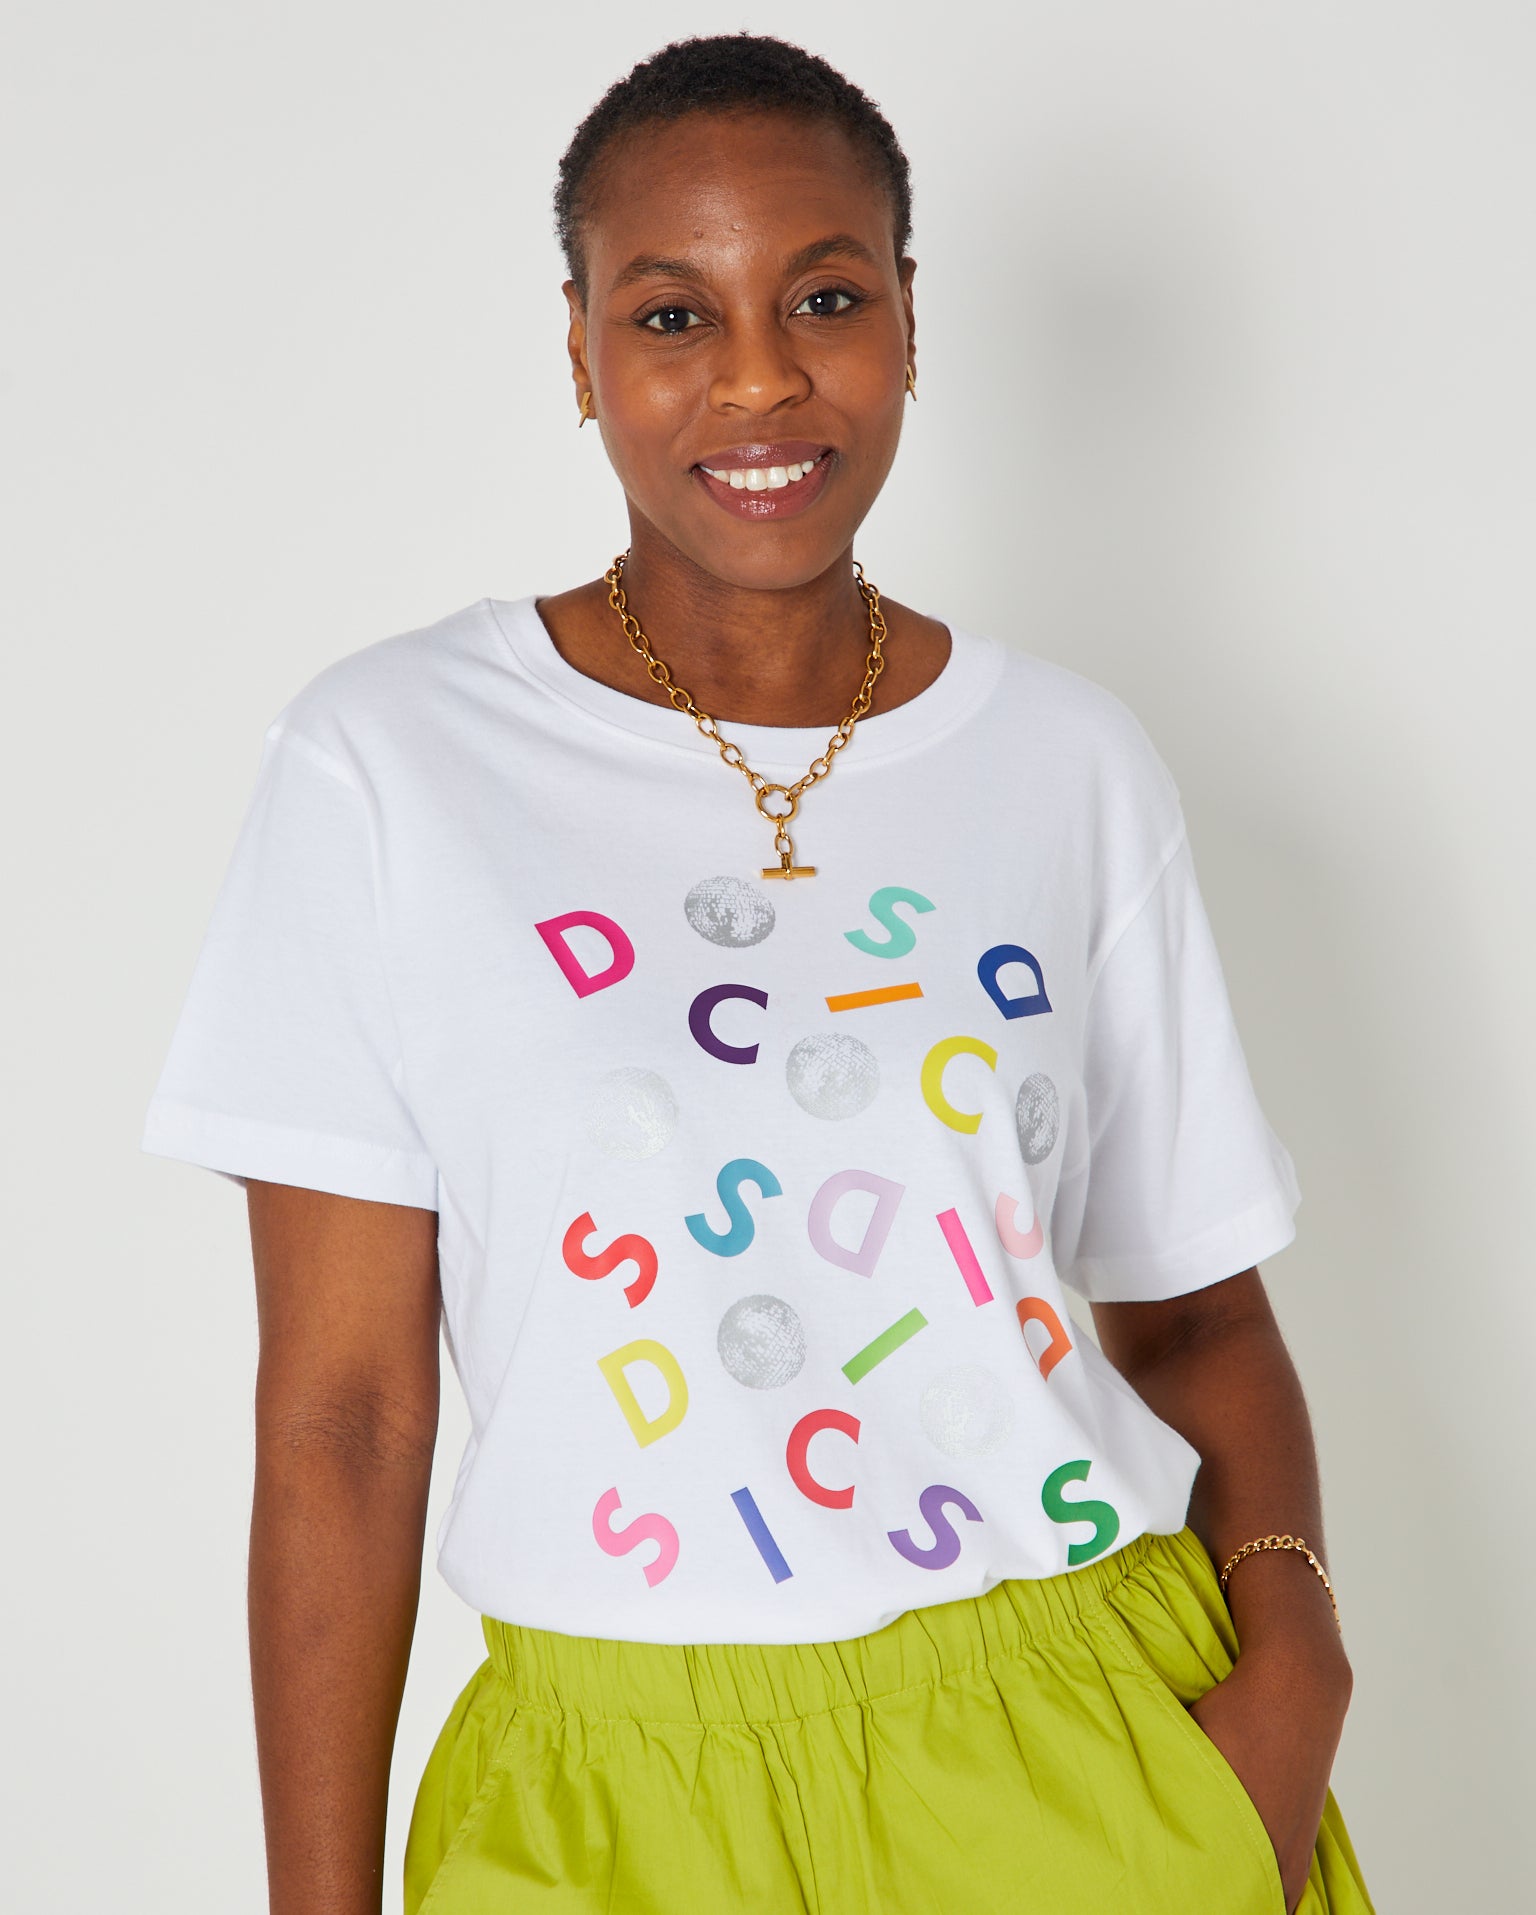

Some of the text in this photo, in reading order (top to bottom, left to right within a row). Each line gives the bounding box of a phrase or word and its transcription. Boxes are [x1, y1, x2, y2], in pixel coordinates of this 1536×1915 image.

[534, 910, 635, 999] D
[844, 887, 936, 959] S
[688, 984, 768, 1064] C
[920, 1036, 998, 1135] C
[685, 1158, 783, 1257] S
[808, 1169, 906, 1278] D
[562, 1211, 659, 1309] S
[597, 1339, 689, 1449] D
[786, 1408, 861, 1510] C
[592, 1487, 680, 1588] S
[887, 1485, 984, 1570] S
[1041, 1459, 1120, 1566] S
